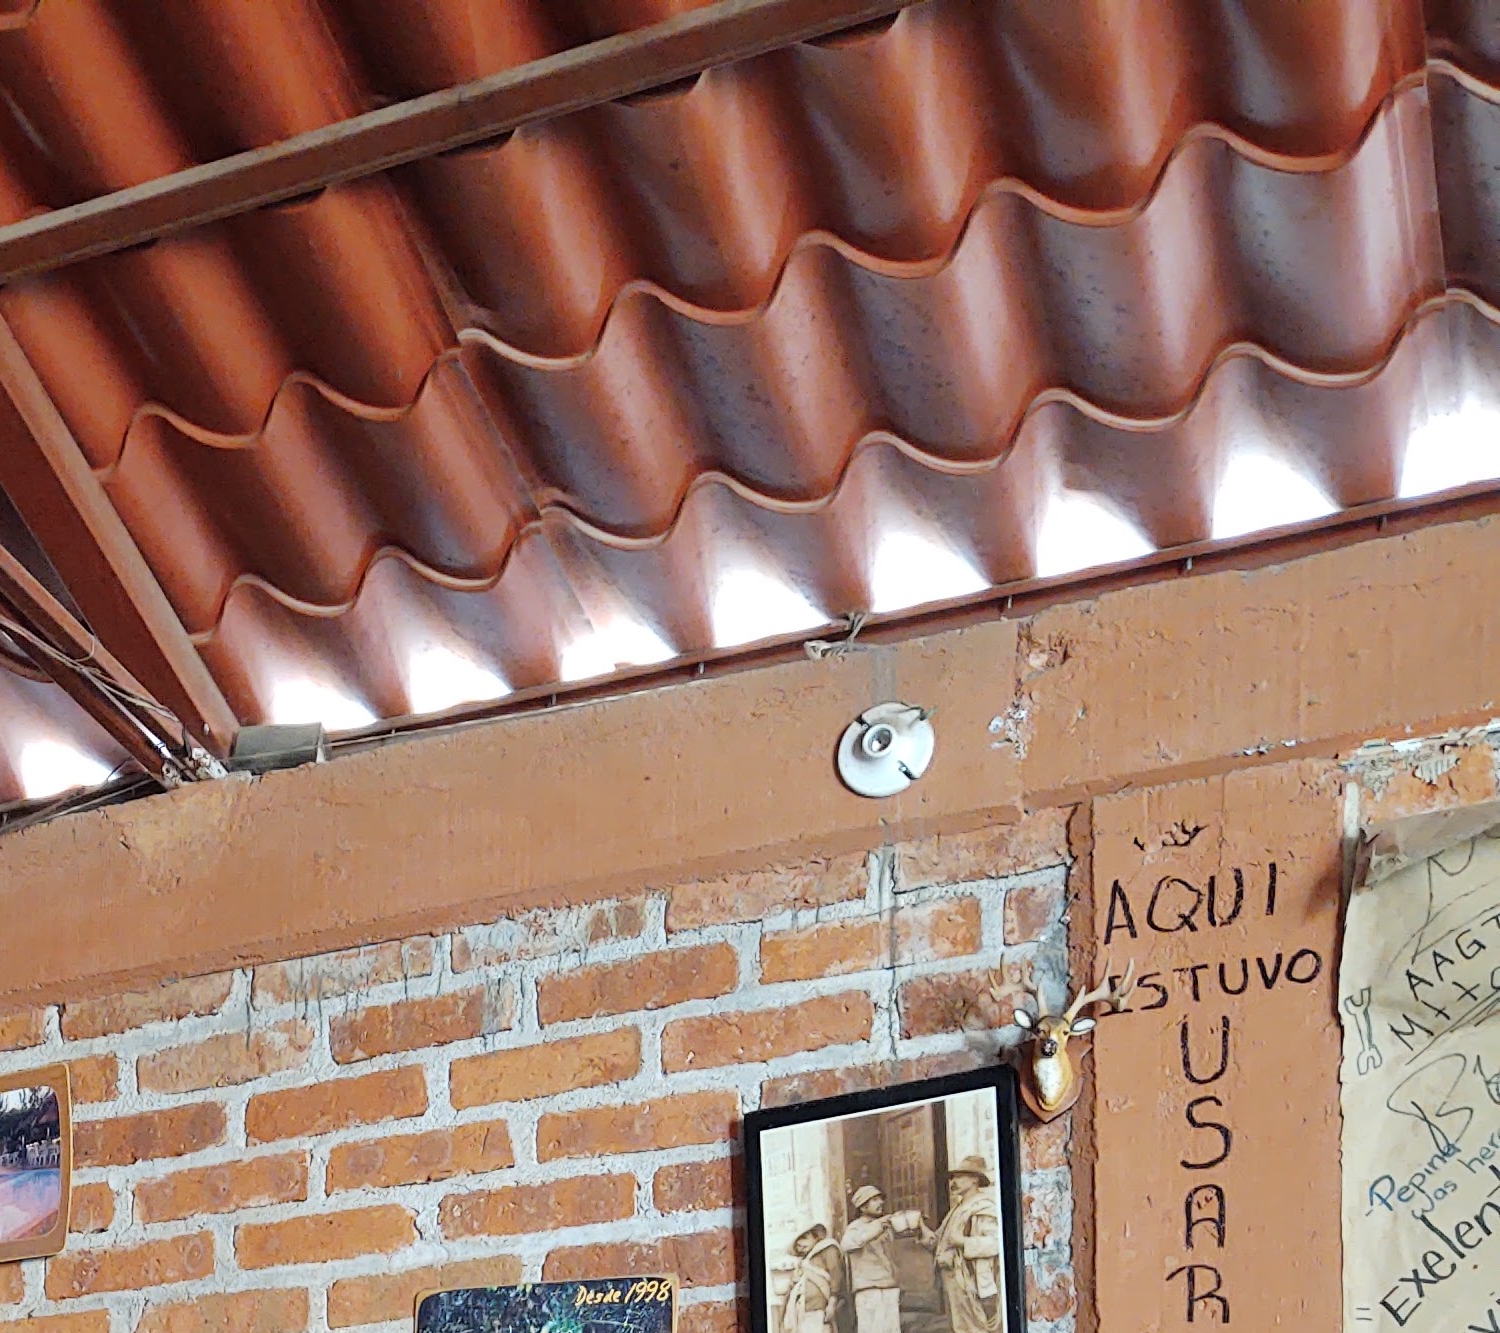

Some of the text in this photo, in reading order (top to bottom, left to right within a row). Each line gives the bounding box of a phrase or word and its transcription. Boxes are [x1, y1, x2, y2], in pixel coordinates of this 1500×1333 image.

[1103, 861, 1277, 945] AQUI
[1100, 948, 1322, 1017] ESTUVO
[1457, 1130, 1500, 1174] her
[574, 1279, 672, 1306] Desde 1998
